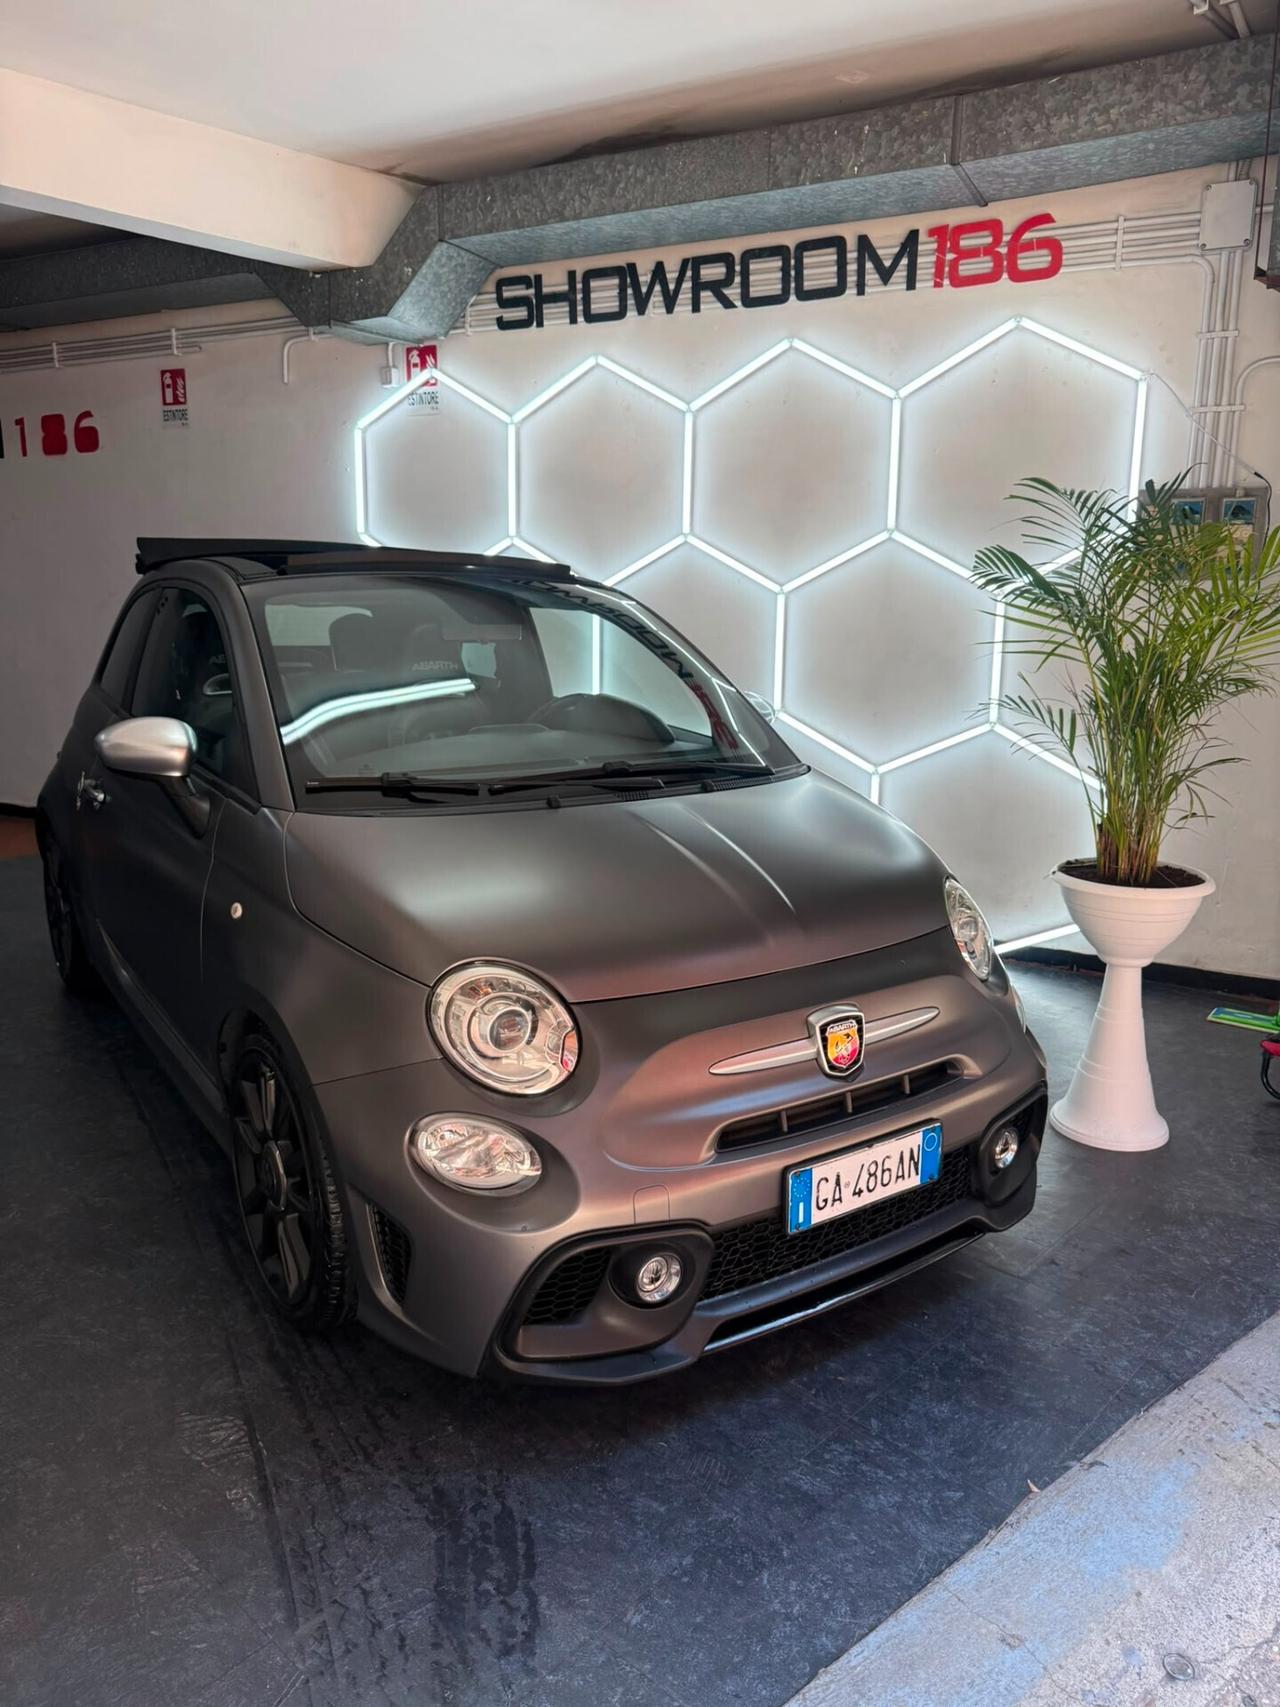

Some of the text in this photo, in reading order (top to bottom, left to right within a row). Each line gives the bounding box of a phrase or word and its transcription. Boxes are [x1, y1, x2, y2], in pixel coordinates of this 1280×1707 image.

[0, 410, 100, 459] 186
[815, 1143, 921, 1211] GA 486AN
